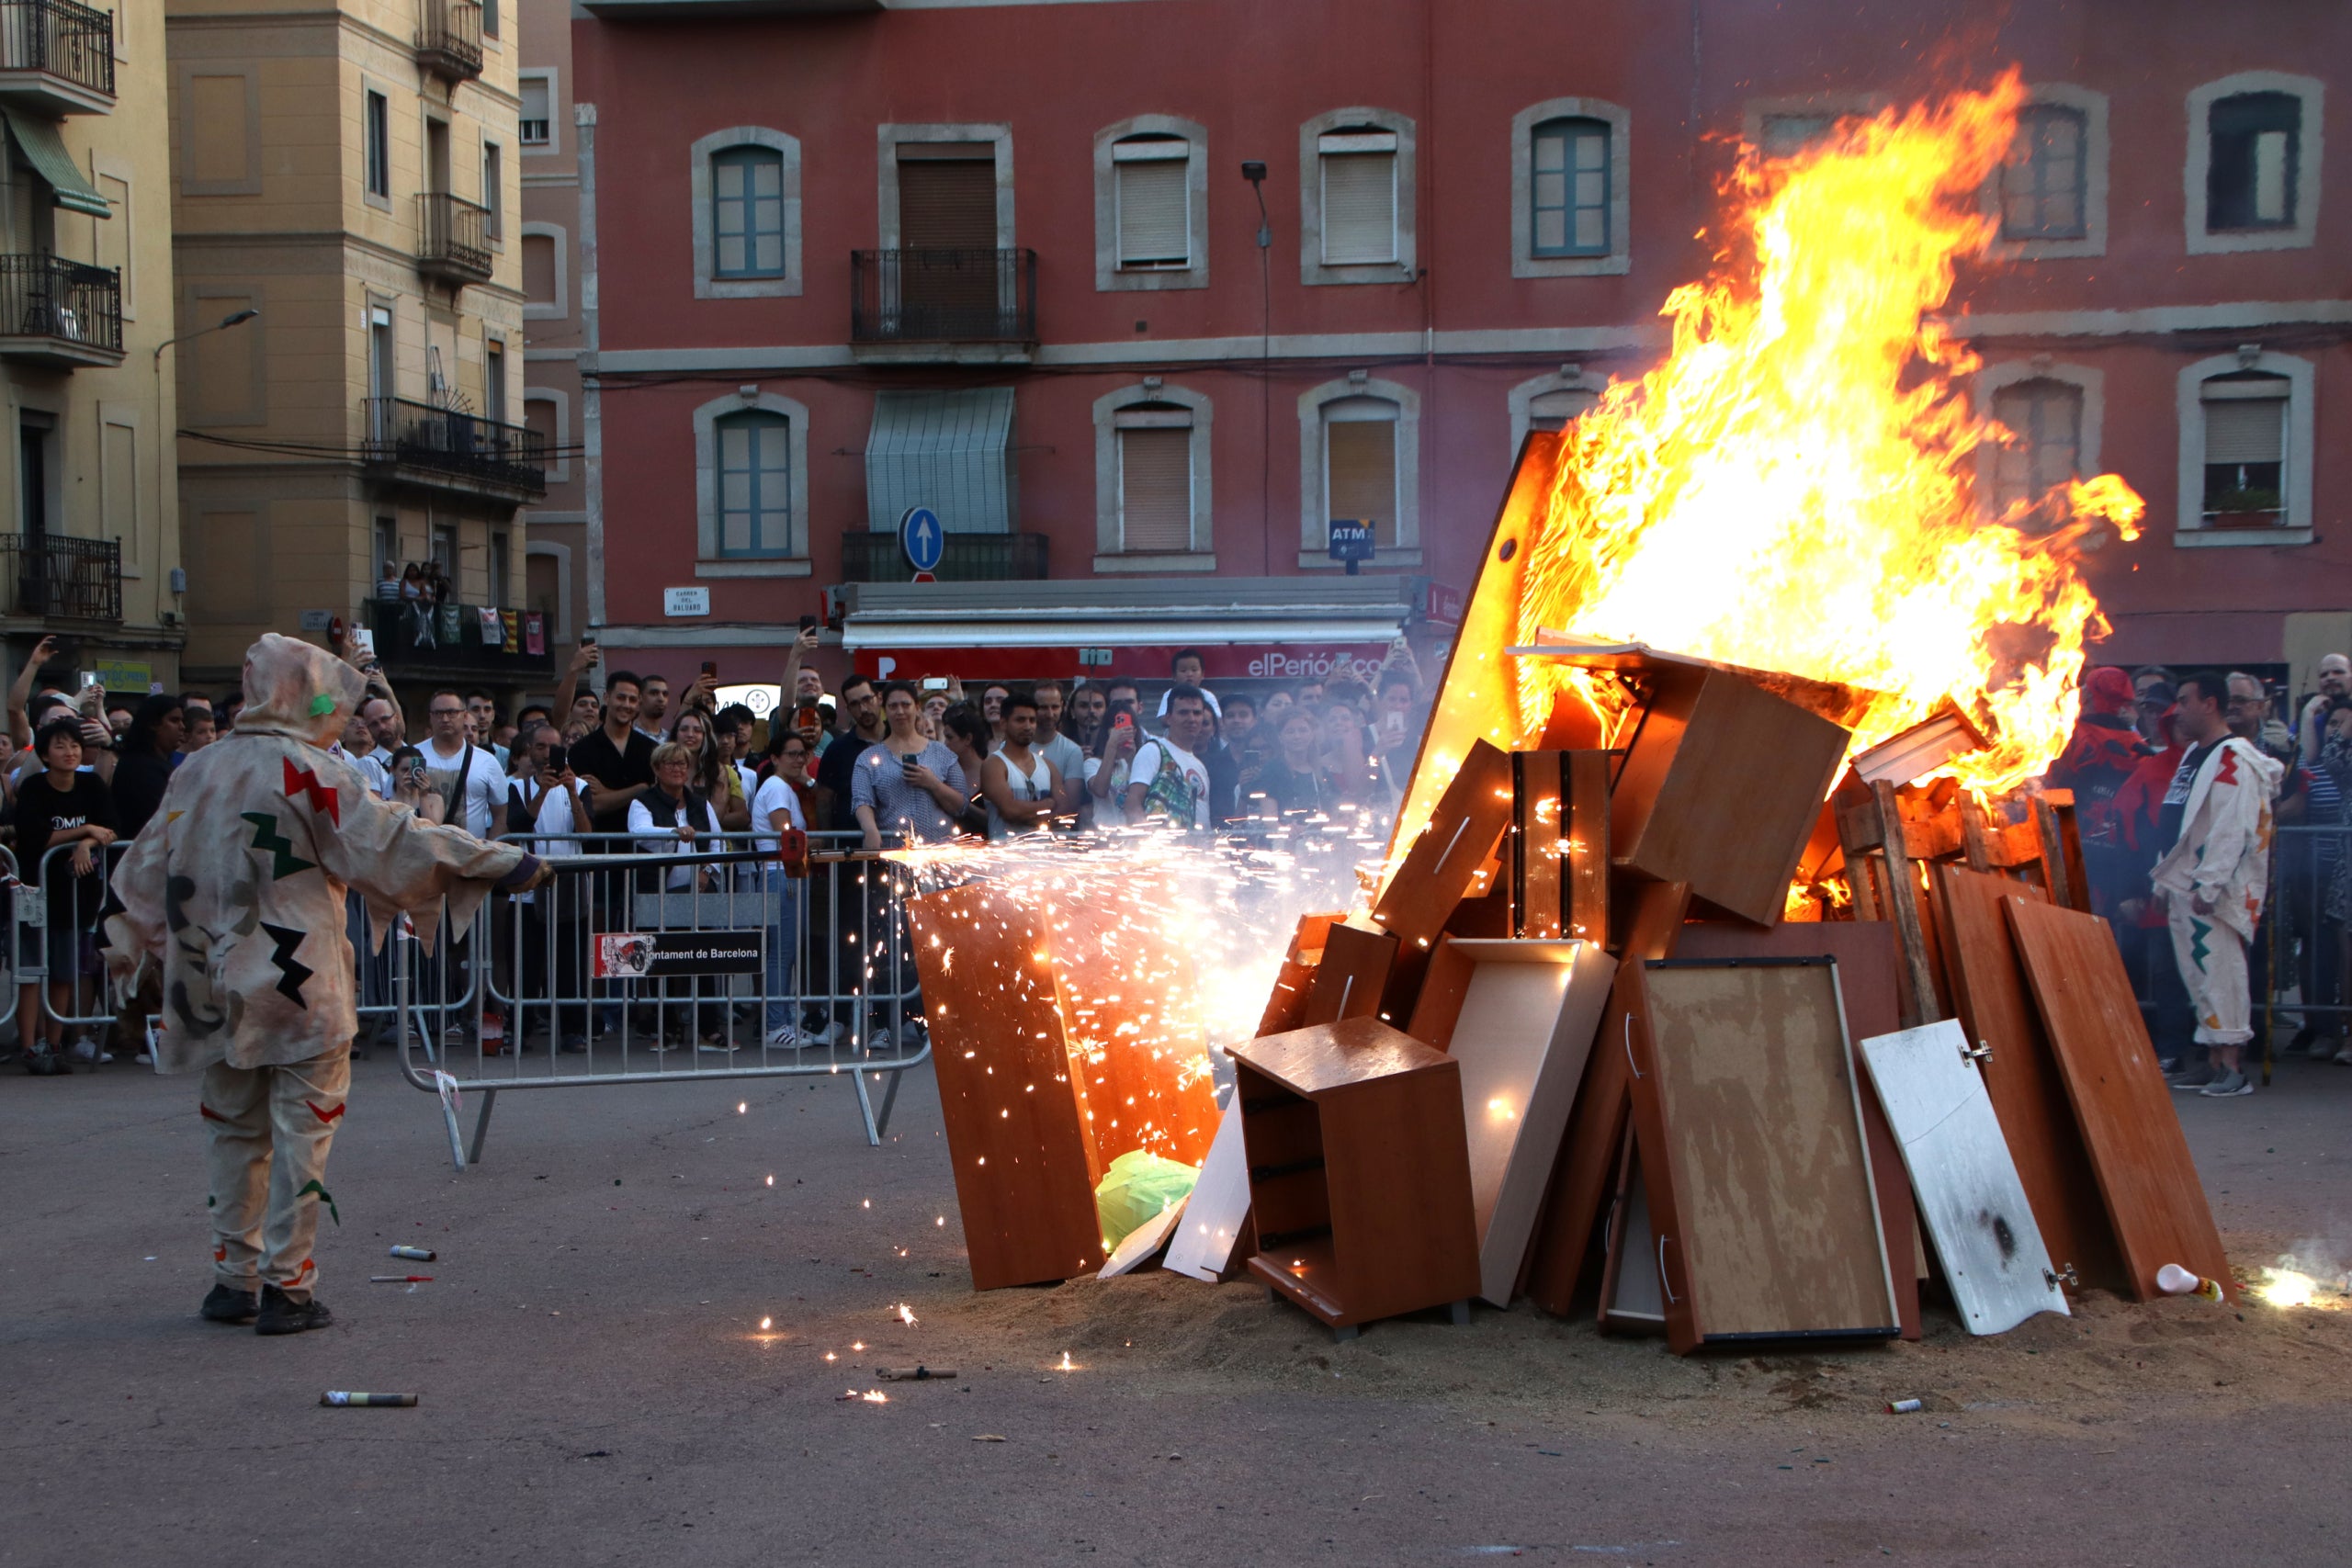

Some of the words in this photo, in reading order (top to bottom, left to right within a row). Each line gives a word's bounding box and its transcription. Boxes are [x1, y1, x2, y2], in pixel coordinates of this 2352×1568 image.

[1332, 528, 1365, 540] ATM
[673, 604, 701, 612] BALUARD
[1249, 652, 1380, 677] elPerióco
[695, 949, 708, 959] de
[710, 948, 759, 958] Barcelona
